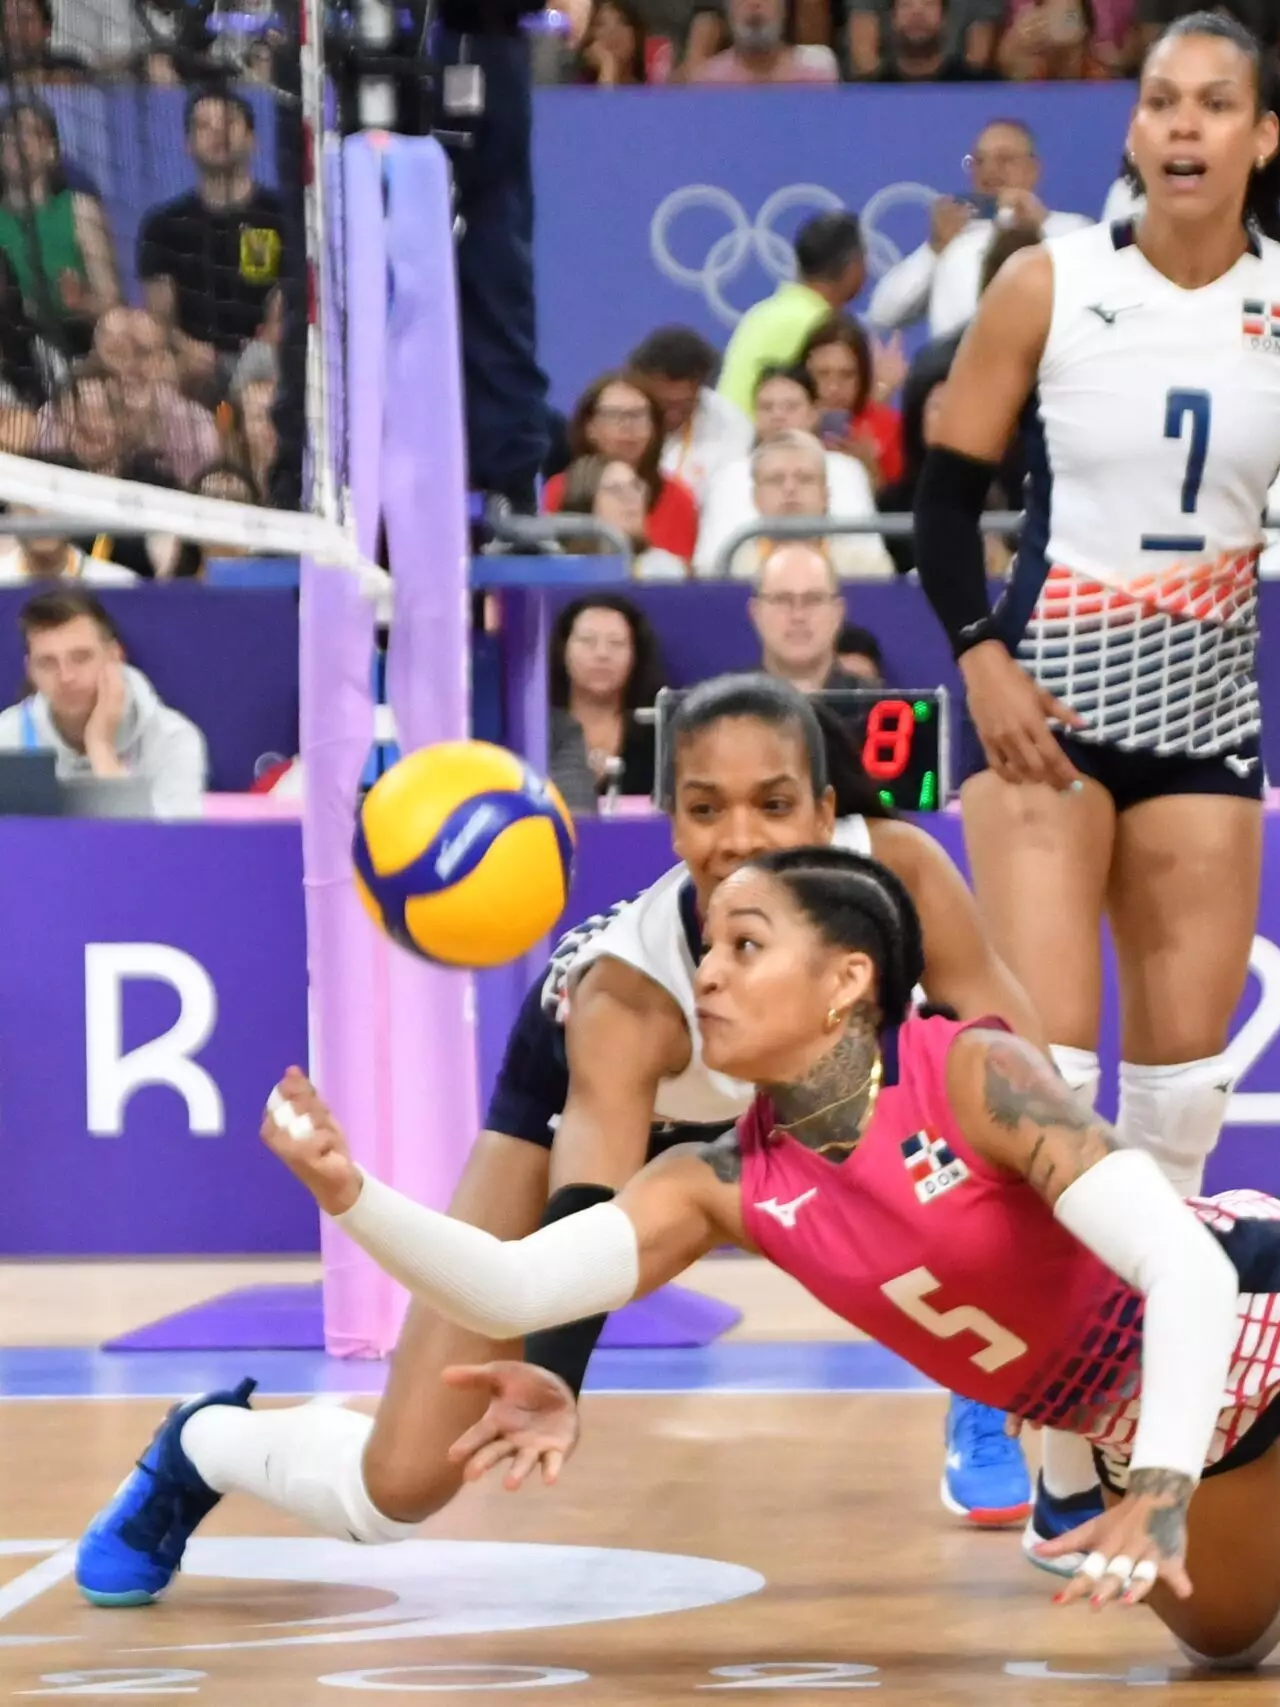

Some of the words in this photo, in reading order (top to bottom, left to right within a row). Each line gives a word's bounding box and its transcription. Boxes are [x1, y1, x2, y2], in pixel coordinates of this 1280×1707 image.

[1164, 386, 1212, 513] 7
[862, 699, 915, 780] 8
[879, 1265, 1029, 1374] 5
